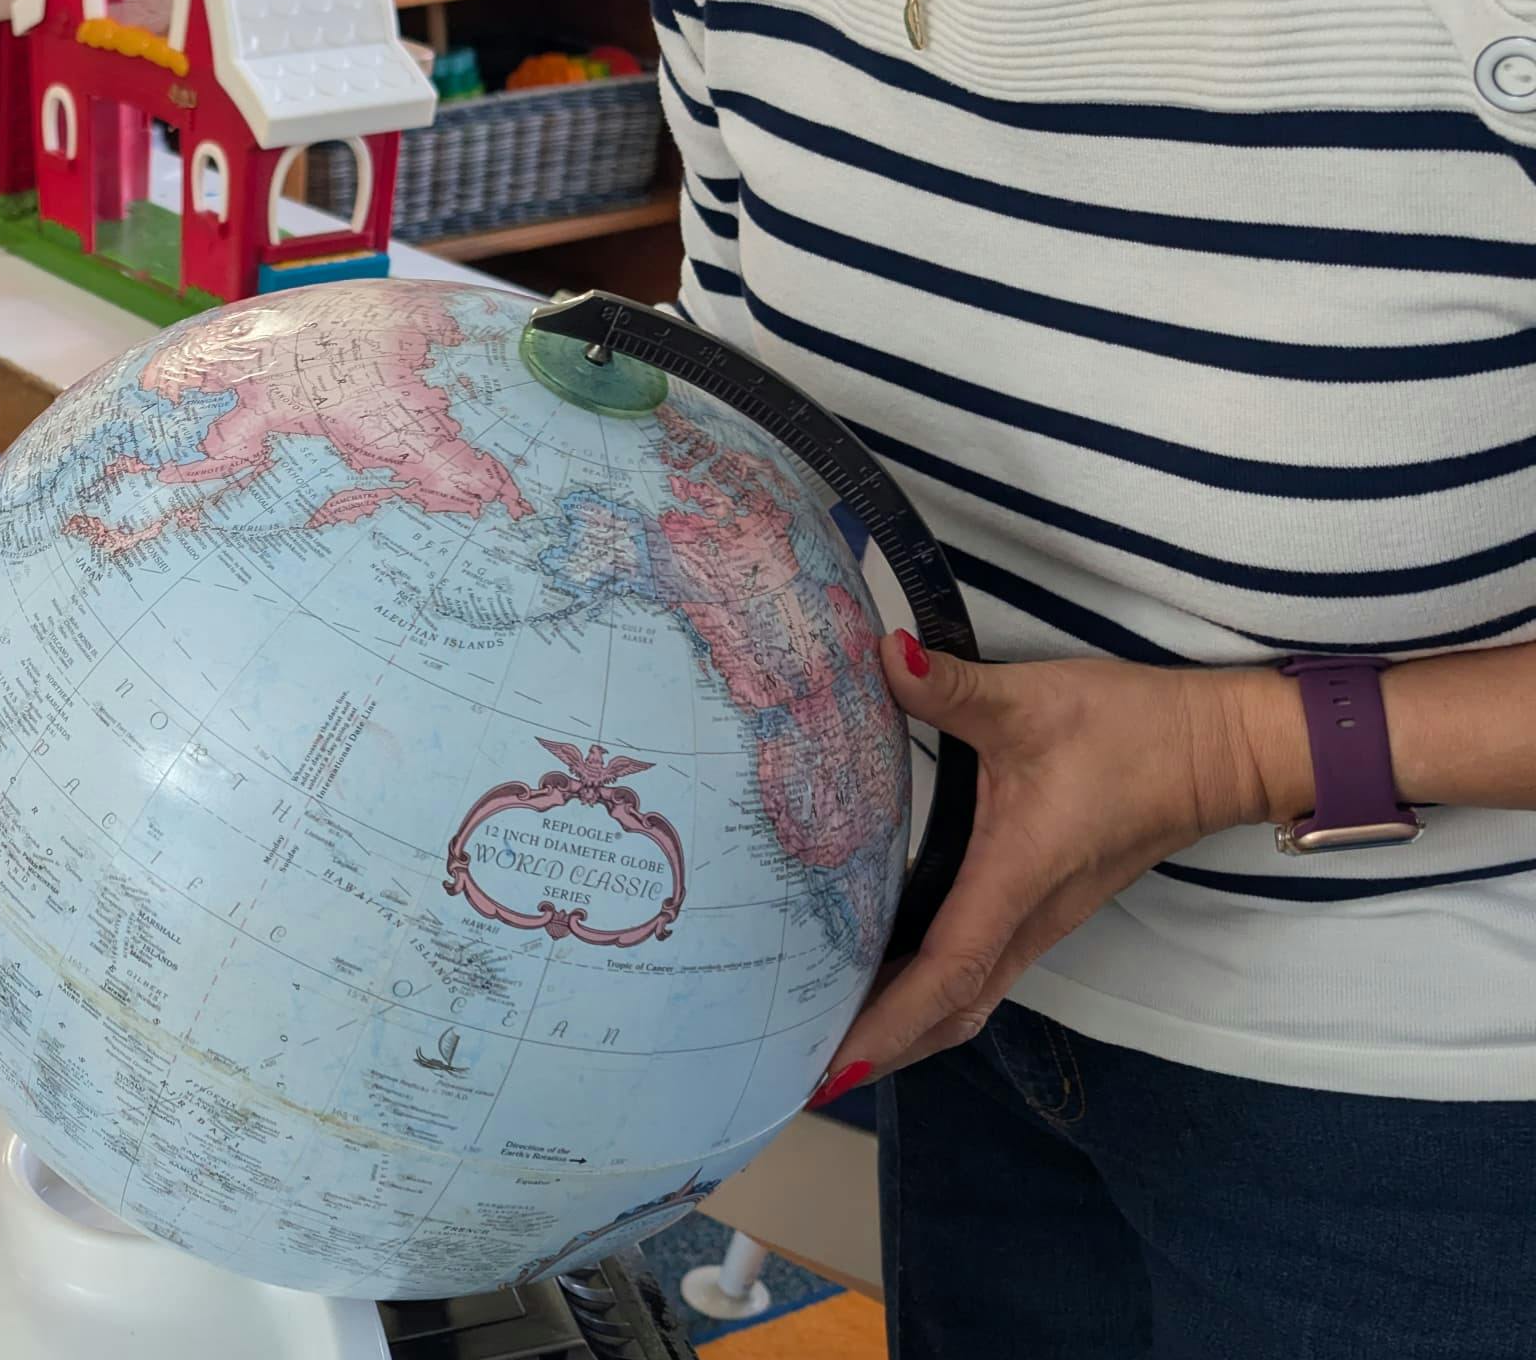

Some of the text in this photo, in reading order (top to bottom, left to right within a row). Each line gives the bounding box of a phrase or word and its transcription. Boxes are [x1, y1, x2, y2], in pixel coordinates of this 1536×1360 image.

[75, 556, 104, 582] JAPAN
[374, 603, 439, 642] ALEUTIAN
[443, 638, 505, 650] ISLANDS
[316, 700, 377, 799] International Date Line
[263, 834, 286, 864] Monday
[484, 824, 665, 874] 12 INCH DIAMETER GLOBE
[475, 842, 664, 901] WORLD CLASSIC
[543, 885, 592, 905] SERIES
[137, 910, 183, 946] MARSHALL
[461, 917, 500, 936] HAWAII
[607, 959, 633, 971] Tropic
[635, 961, 645, 970] of
[646, 962, 675, 973] Cancer
[500, 1148, 568, 1163] Earth's Rotation
[505, 1140, 571, 1155] Direction of the
